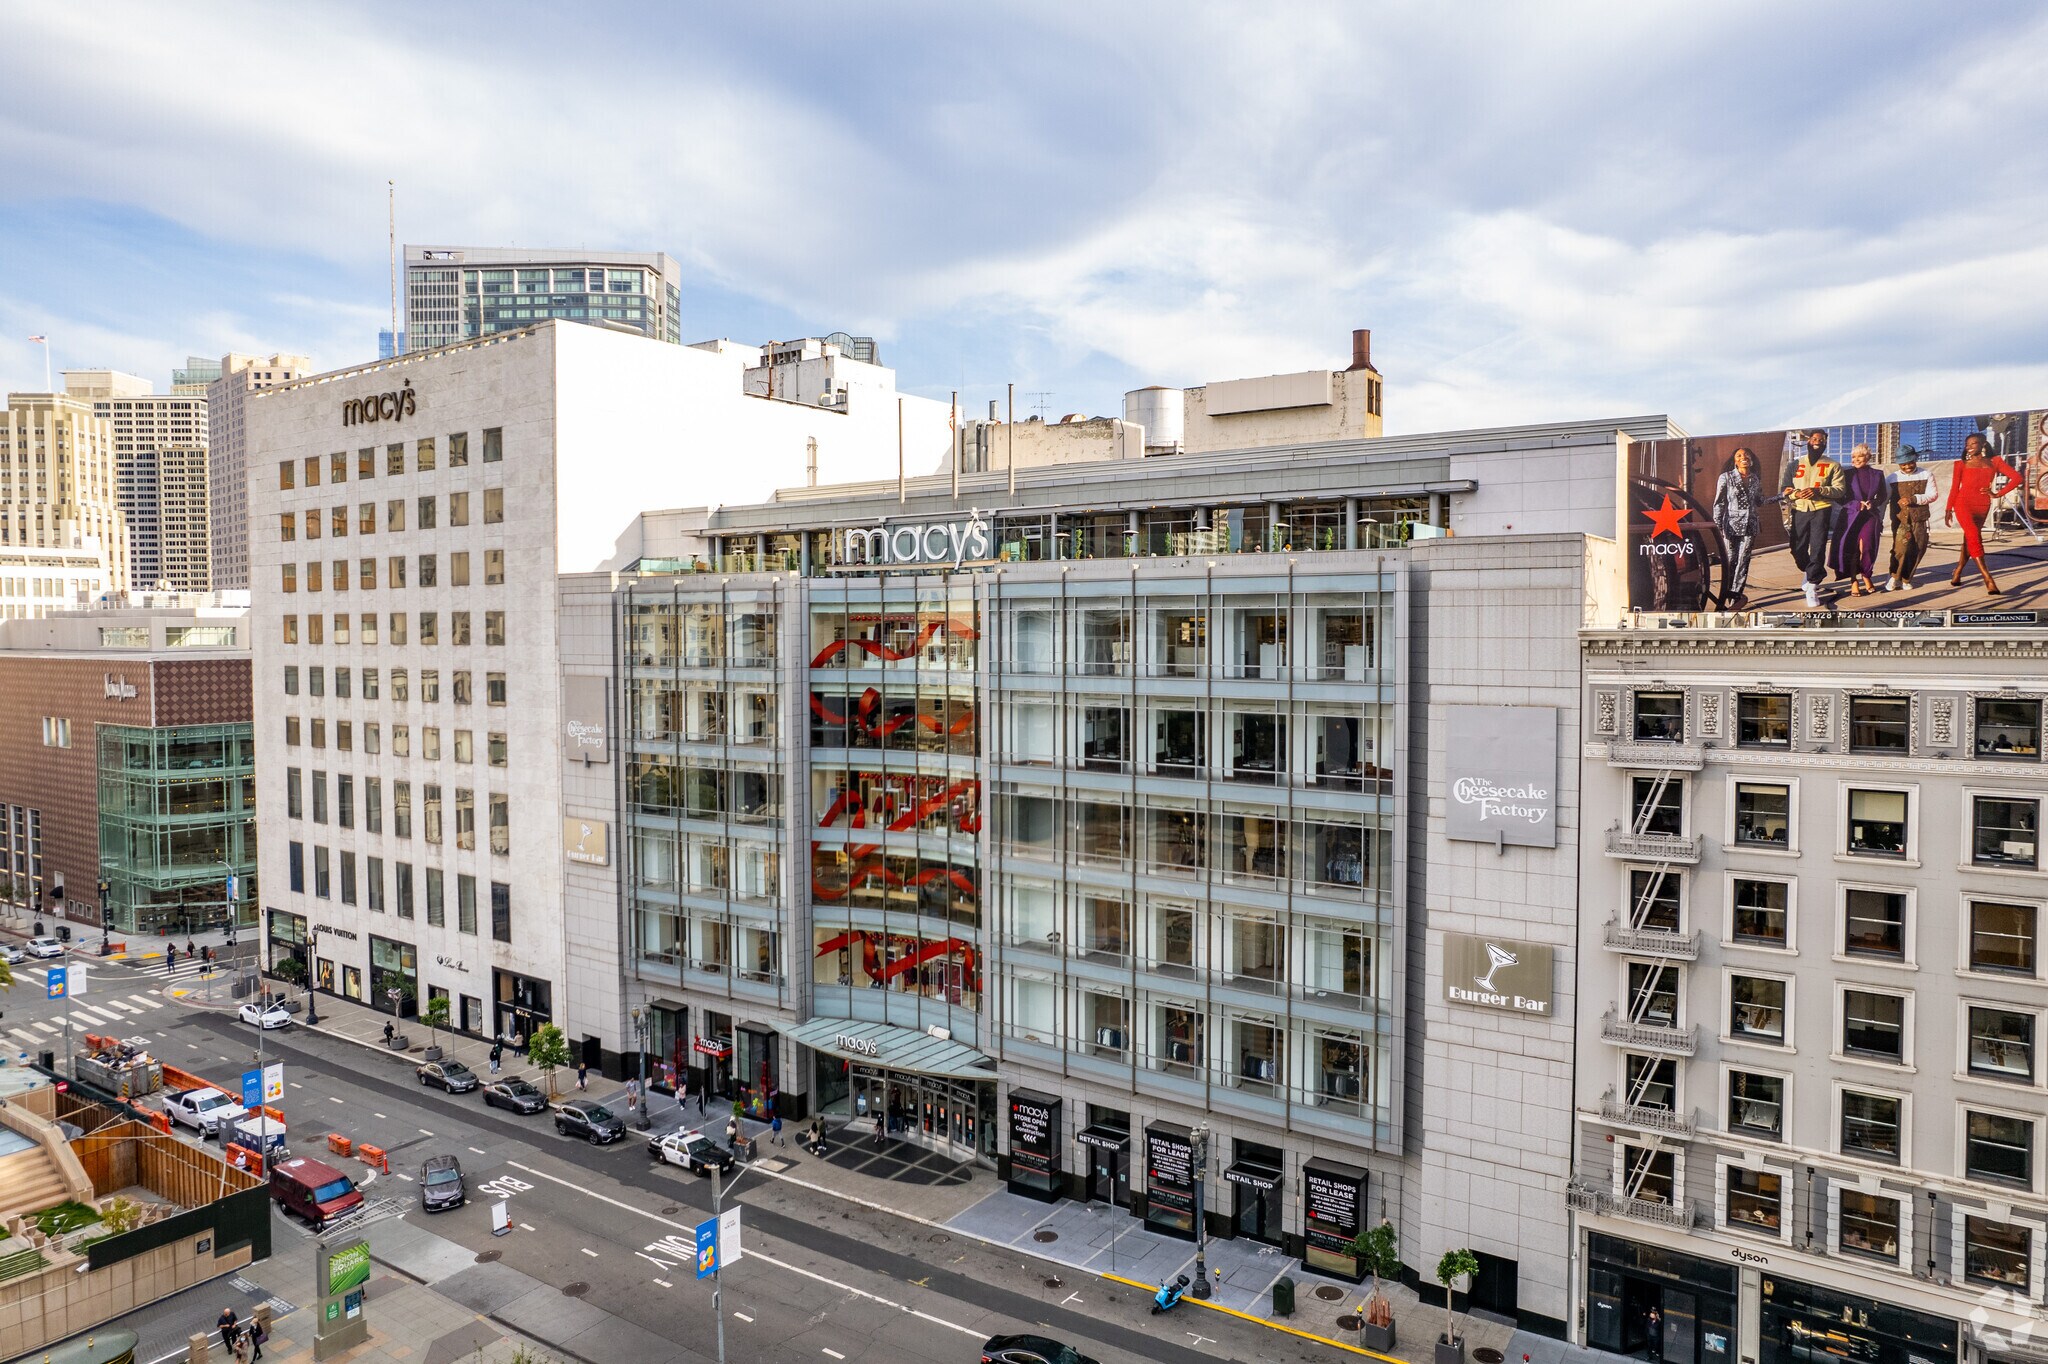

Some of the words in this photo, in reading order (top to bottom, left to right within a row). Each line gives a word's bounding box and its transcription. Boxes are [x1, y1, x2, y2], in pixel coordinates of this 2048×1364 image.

[343, 378, 416, 426] macy's
[846, 507, 989, 570] macy's
[1640, 538, 1694, 559] macy's
[1475, 777, 1493, 787] The
[1453, 777, 1548, 804] Cheesecake
[1472, 796, 1548, 824] Factory
[333, 927, 357, 941] VUITTON
[1449, 986, 1510, 1006] Burger
[1514, 995, 1548, 1012] Bar
[700, 1038, 723, 1051] macy's
[836, 1033, 877, 1055] macy's
[1013, 1113, 1031, 1123] STORE
[1032, 1118, 1047, 1127] OPEN
[1020, 1104, 1049, 1120] macy's
[1015, 1125, 1046, 1138] Construction
[1022, 1122, 1038, 1131] During
[1079, 1134, 1101, 1146] RETAIL
[1102, 1140, 1120, 1150] SHOP
[1150, 1137, 1171, 1148] RETAIL
[1172, 1143, 1192, 1153] SHOPS
[1152, 1145, 1166, 1154] FOR
[1167, 1149, 1190, 1160] LEASE
[478, 1175, 534, 1198] BUS
[1226, 1172, 1251, 1185] RETAIL
[1253, 1179, 1273, 1189] SHOP
[1309, 1176, 1332, 1187] RETAIL
[1333, 1182, 1356, 1193] SHOPS
[1311, 1184, 1327, 1194] FOR
[1329, 1189, 1354, 1200] LEASE
[333, 1251, 359, 1266] UNION
[1731, 1248, 1769, 1264] dyson
[333, 1256, 364, 1273] SQUARE
